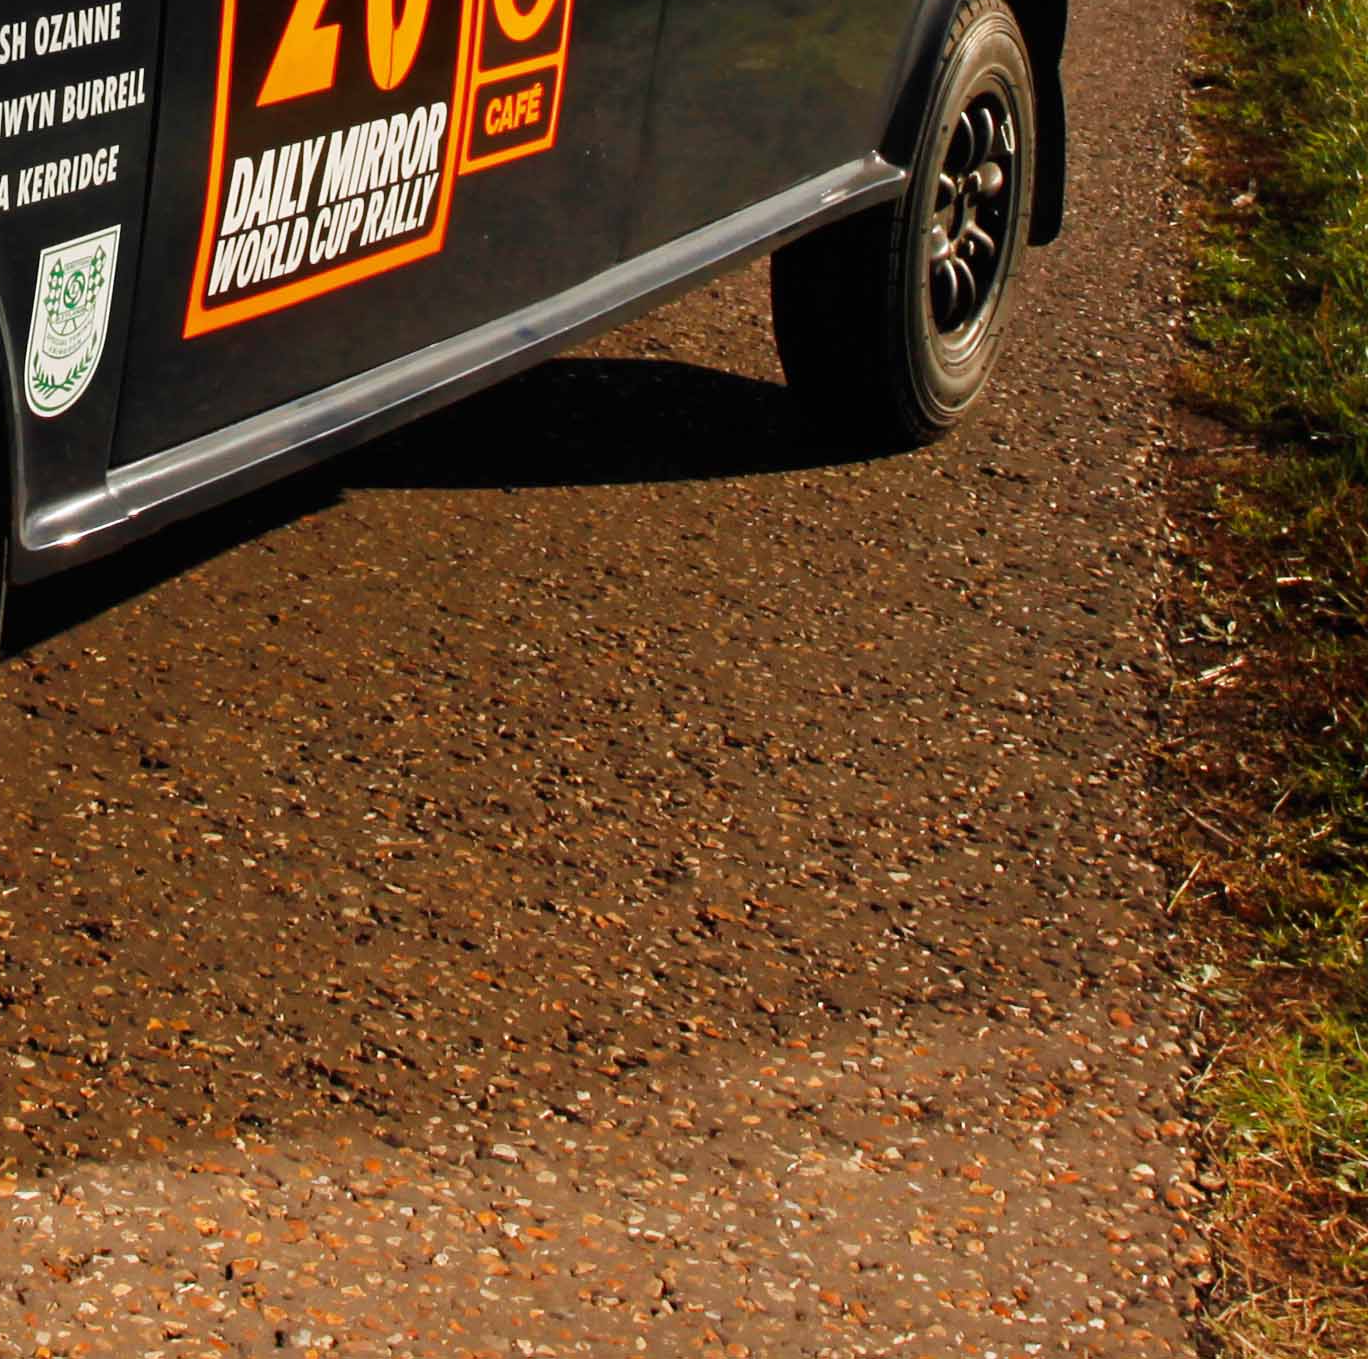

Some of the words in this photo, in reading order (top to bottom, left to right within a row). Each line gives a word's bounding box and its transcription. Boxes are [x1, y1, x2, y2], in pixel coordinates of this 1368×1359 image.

[34, 1, 122, 56] OZANNE
[62, 67, 145, 124] BURRELL
[484, 82, 543, 137] CAFÉ
[16, 144, 120, 208] KERRIDGE
[220, 136, 326, 237] DAILY
[317, 101, 448, 207] MIRROR
[207, 216, 309, 297] WORLD
[308, 196, 365, 265] CUP
[359, 171, 441, 247] RALLY
